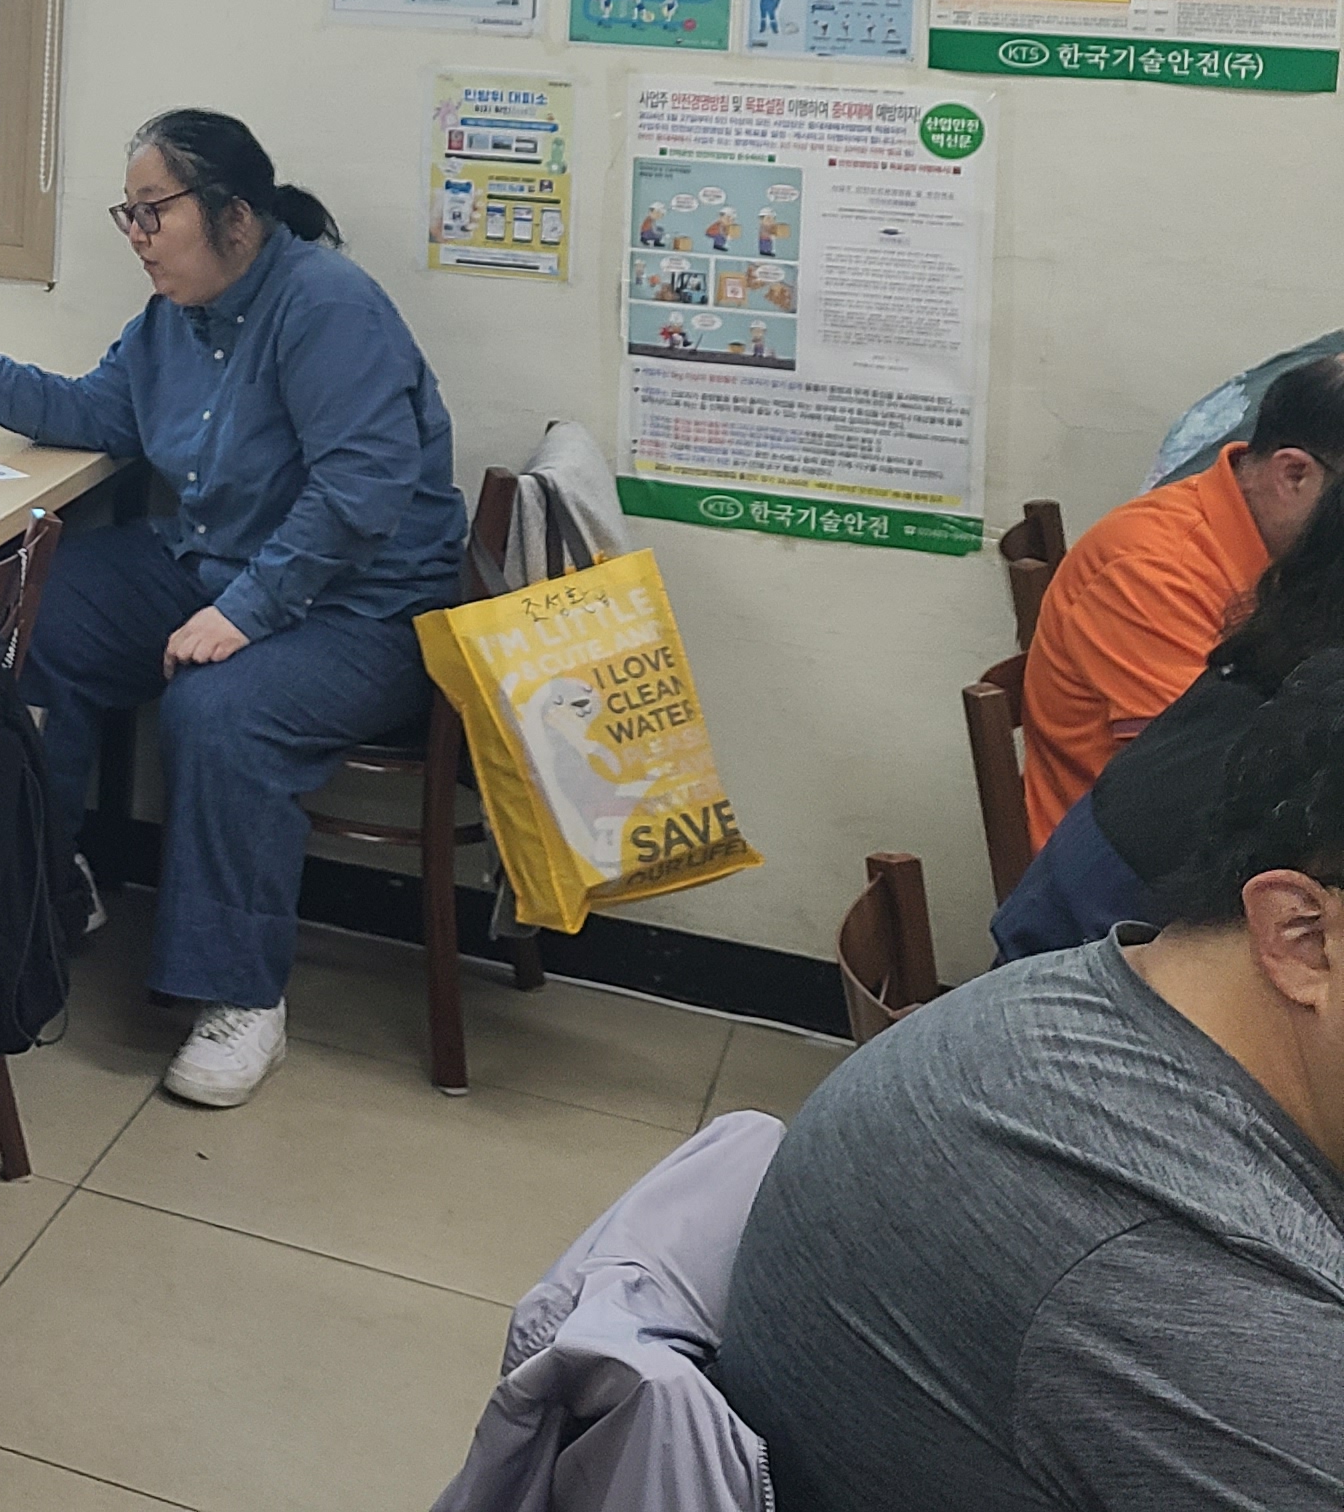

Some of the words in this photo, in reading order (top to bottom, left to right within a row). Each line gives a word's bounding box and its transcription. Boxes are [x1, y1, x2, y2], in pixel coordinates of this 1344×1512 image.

[1008, 46, 1040, 61] KTS
[1057, 43, 1264, 80] 한국기술안전(주)
[509, 91, 548, 105] 대피소
[640, 90, 669, 108] 사업주
[732, 96, 742, 112] 및
[745, 97, 784, 115] 목표설정
[925, 117, 980, 134] 산업안전
[706, 502, 735, 516] KTS
[749, 501, 890, 539] 한국기술안전
[478, 632, 531, 665] I'M
[534, 587, 655, 648] LITTLE
[539, 638, 607, 675] CUTE
[593, 667, 606, 689] I
[607, 645, 675, 686] LOVE
[630, 799, 740, 863] SAVE
